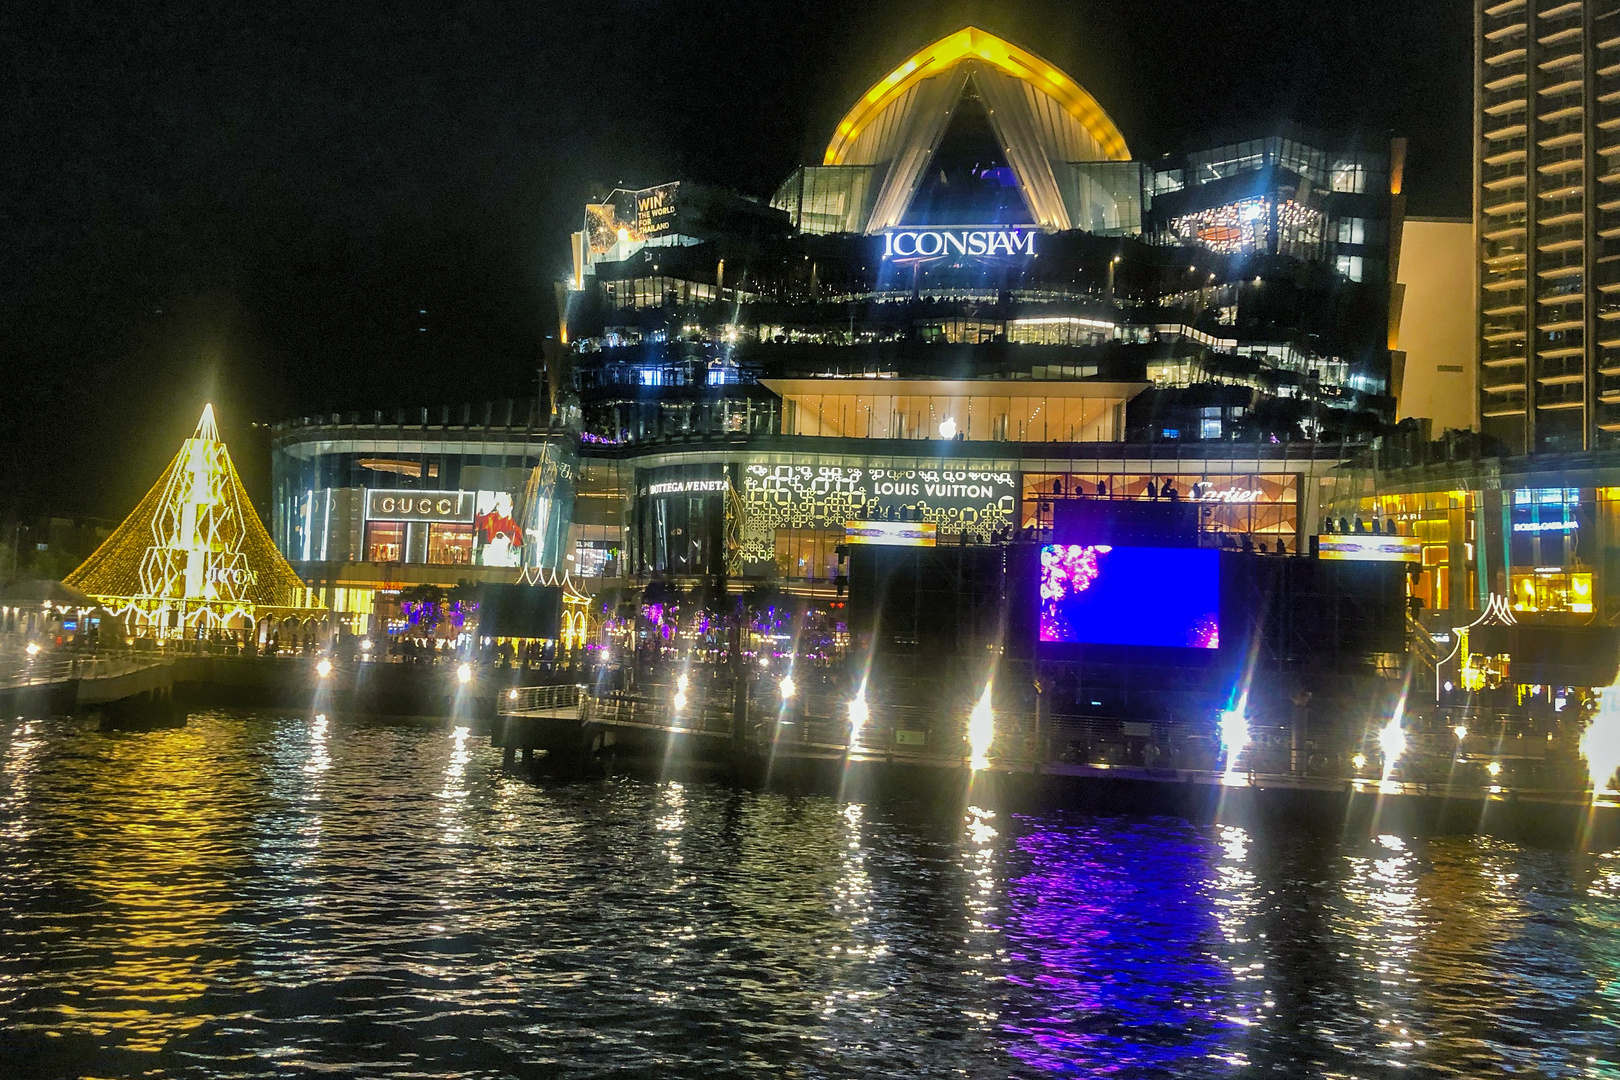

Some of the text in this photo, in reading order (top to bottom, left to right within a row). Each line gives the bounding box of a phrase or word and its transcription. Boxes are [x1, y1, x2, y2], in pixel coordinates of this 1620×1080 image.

[638, 195, 662, 211] WIN
[638, 206, 675, 219] THE WORLD
[639, 219, 651, 227] FOR
[639, 222, 669, 234] THAILAND
[884, 231, 1036, 256] ICONSIAM
[649, 482, 683, 494] BOTTEGA
[686, 480, 730, 490] VENETA
[874, 482, 993, 498] LOUIS VUITTON
[1189, 481, 1263, 502] Cartier
[381, 497, 460, 515] GUCCI
[899, 734, 905, 742] 2
